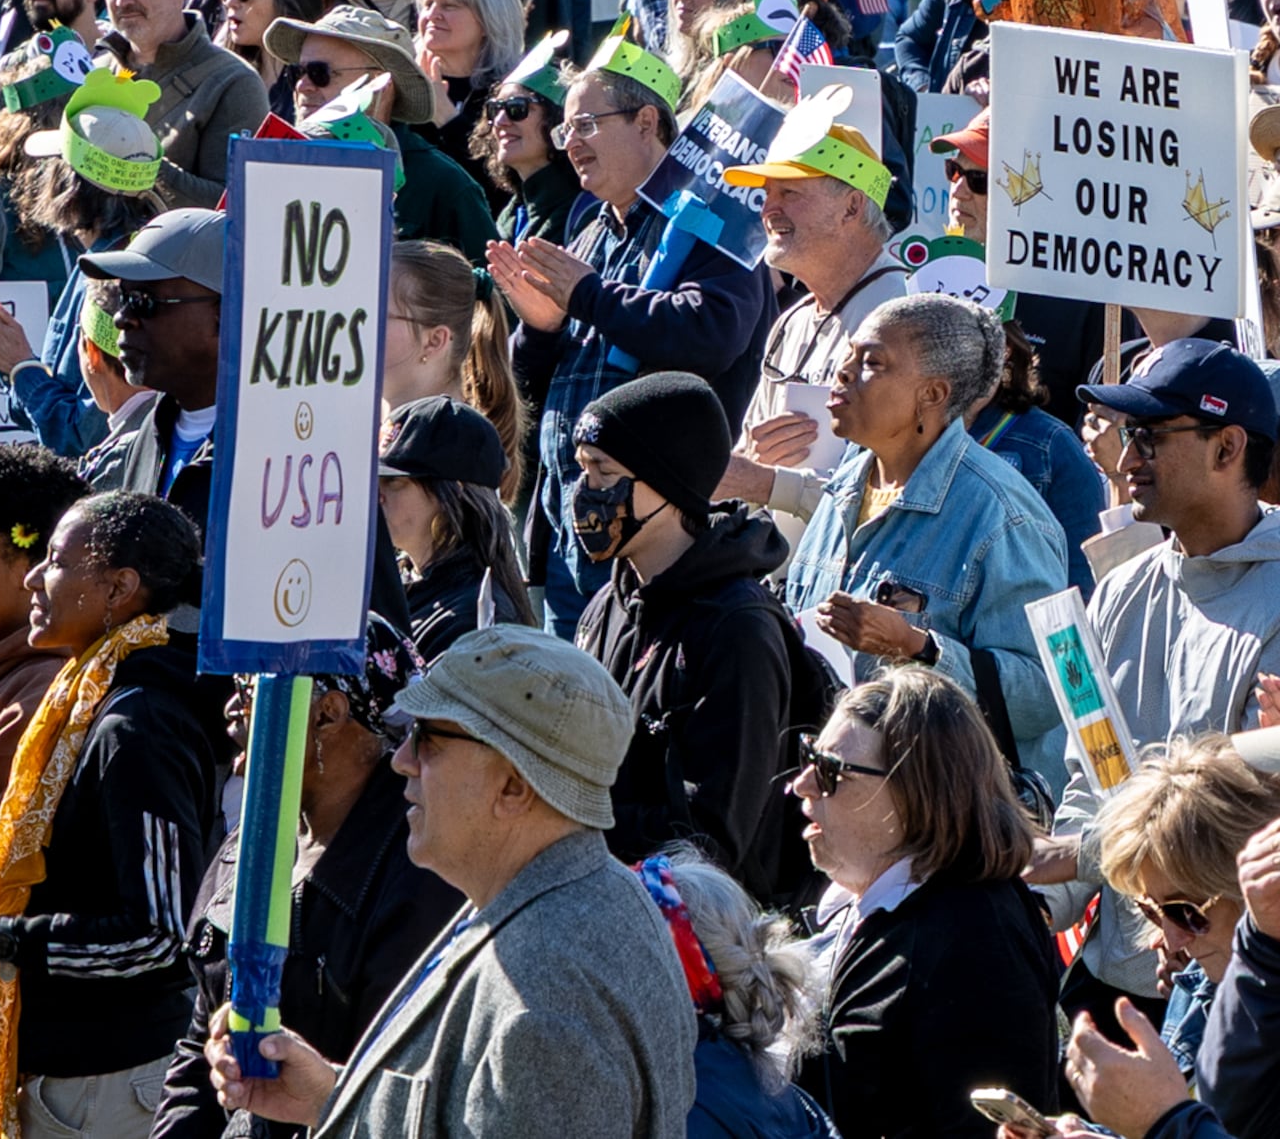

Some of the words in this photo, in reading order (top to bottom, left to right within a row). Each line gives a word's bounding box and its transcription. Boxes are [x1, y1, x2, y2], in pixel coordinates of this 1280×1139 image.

[1054, 56, 1100, 98] WE
[1120, 65, 1181, 109] ARE
[692, 106, 768, 166] VETERANS
[1054, 115, 1180, 167] LOSING
[670, 135, 768, 214] DEMOCRAC
[1076, 178, 1149, 225] OUR
[282, 199, 351, 287] NO
[1006, 229, 1223, 292] DEMOCRACY
[250, 307, 368, 389] KINGS
[261, 450, 344, 529] USA
